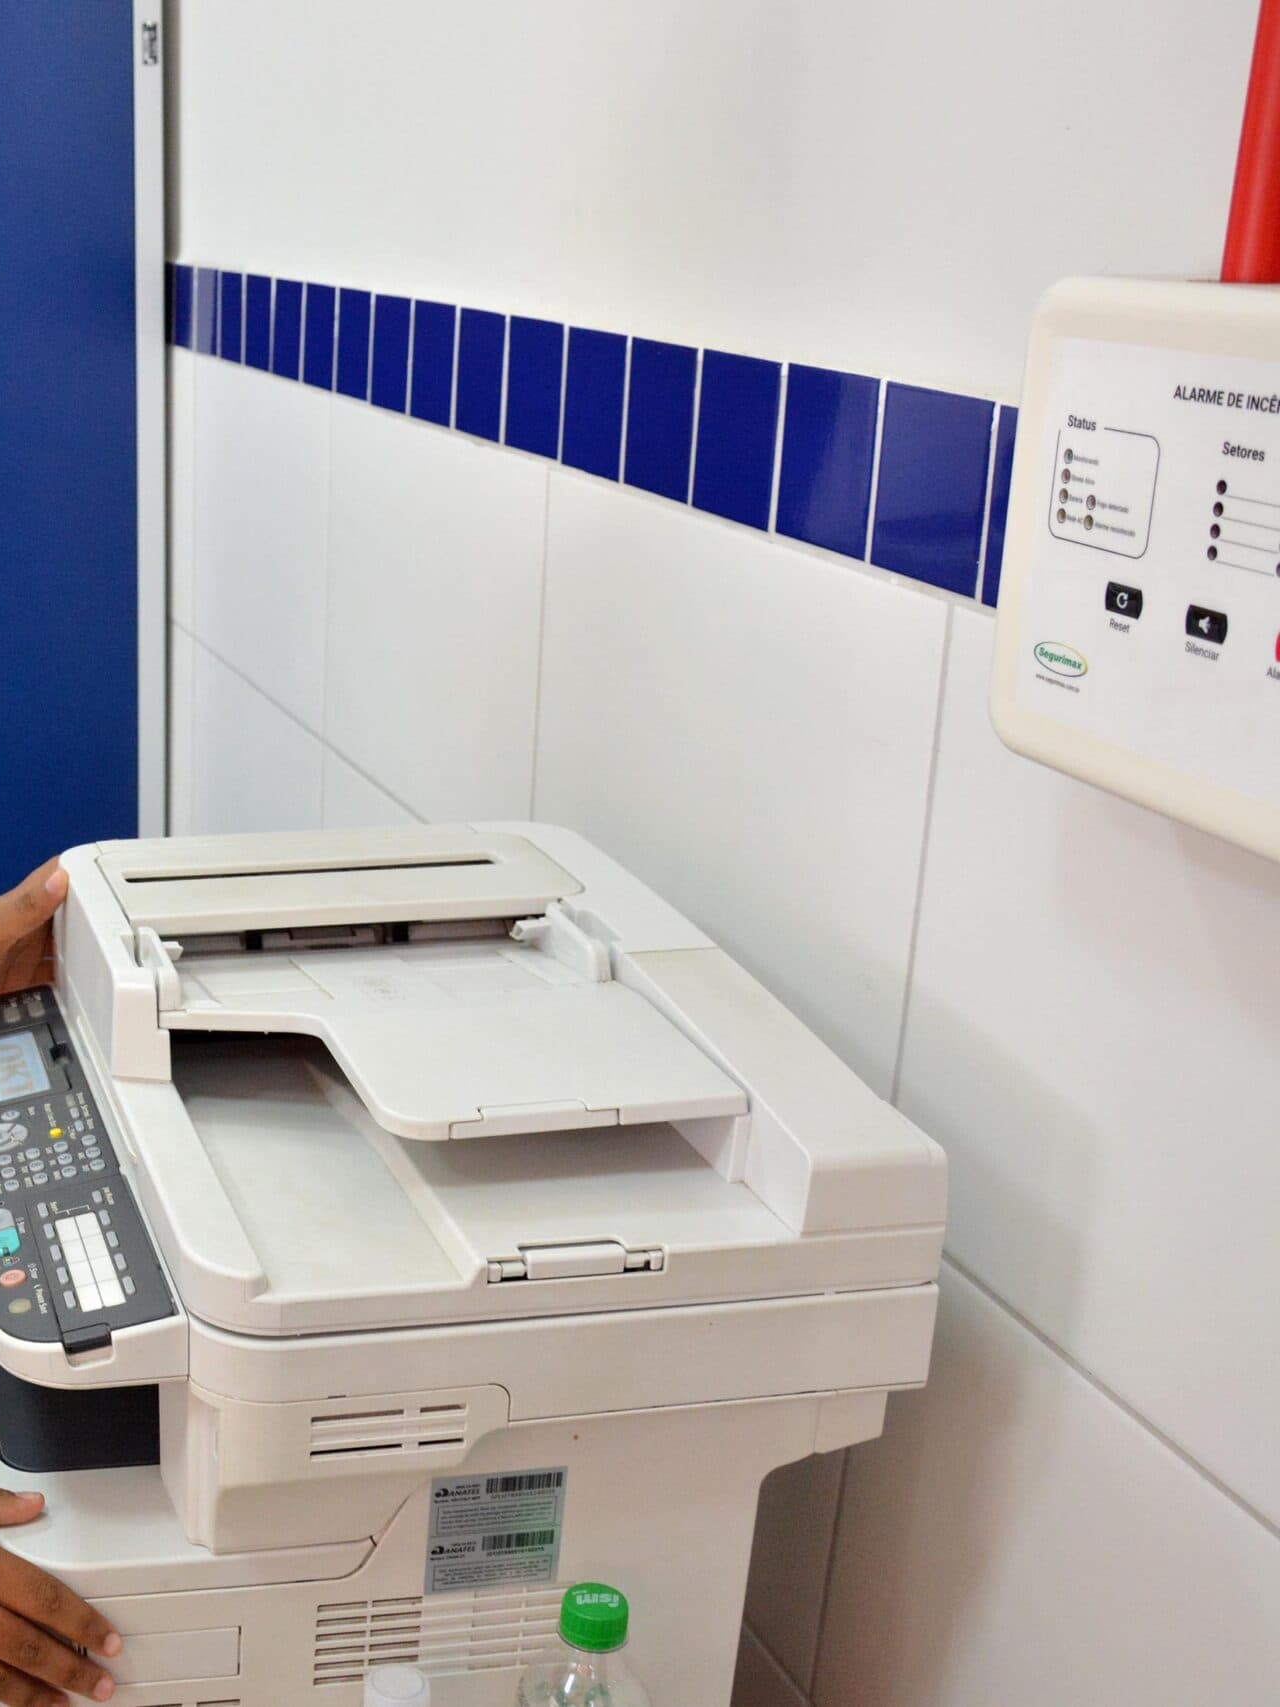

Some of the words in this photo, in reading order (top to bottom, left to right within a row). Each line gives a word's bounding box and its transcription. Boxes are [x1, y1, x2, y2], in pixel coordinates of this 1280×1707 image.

[1173, 384, 1225, 406] ALARME
[1227, 391, 1244, 408] DE
[1067, 414, 1097, 431] Status
[1222, 441, 1265, 462] Setores
[1109, 618, 1130, 634] Reset
[1038, 646, 1082, 670] Segurimax
[1184, 641, 1220, 661] Silenciar
